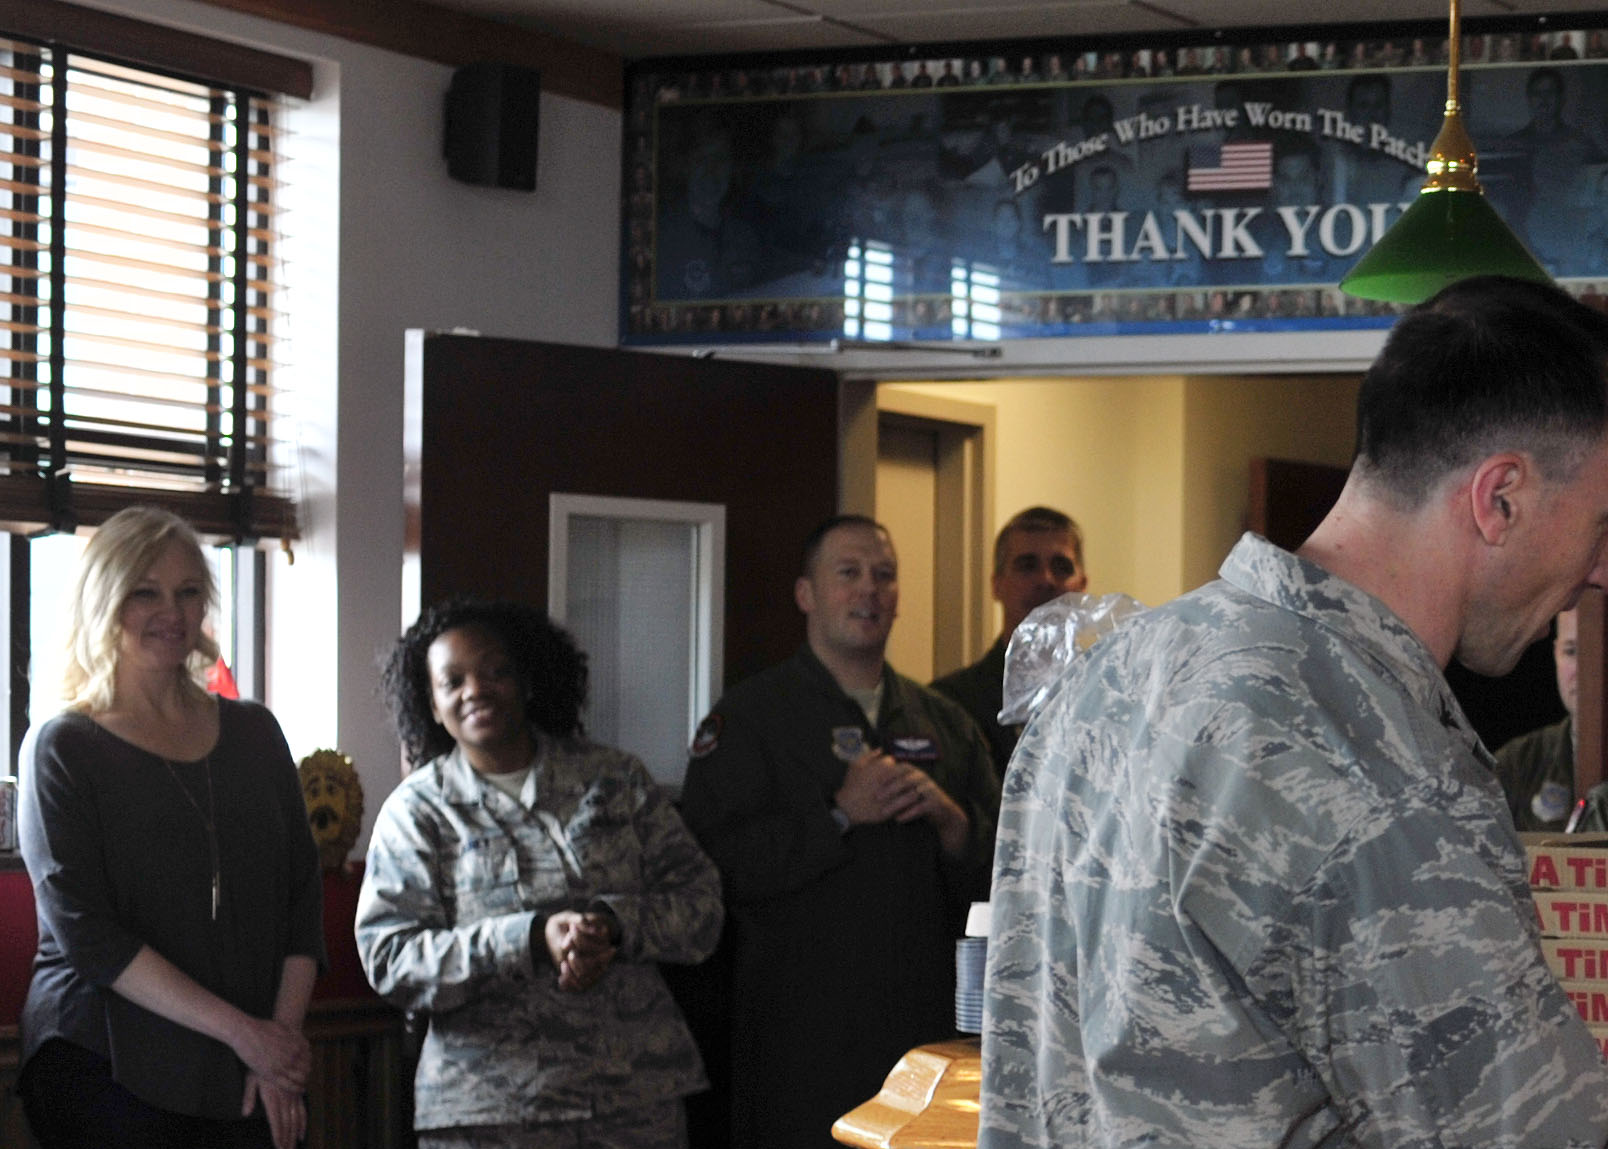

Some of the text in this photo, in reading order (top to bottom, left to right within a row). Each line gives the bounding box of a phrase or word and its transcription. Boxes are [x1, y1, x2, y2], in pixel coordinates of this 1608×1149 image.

[1010, 162, 1038, 193] To
[1043, 131, 1107, 174] Those
[1114, 112, 1171, 143] Who
[1176, 104, 1238, 131] Have
[1244, 102, 1312, 130] Worn
[1318, 108, 1364, 144] The
[1044, 207, 1263, 263] THANK
